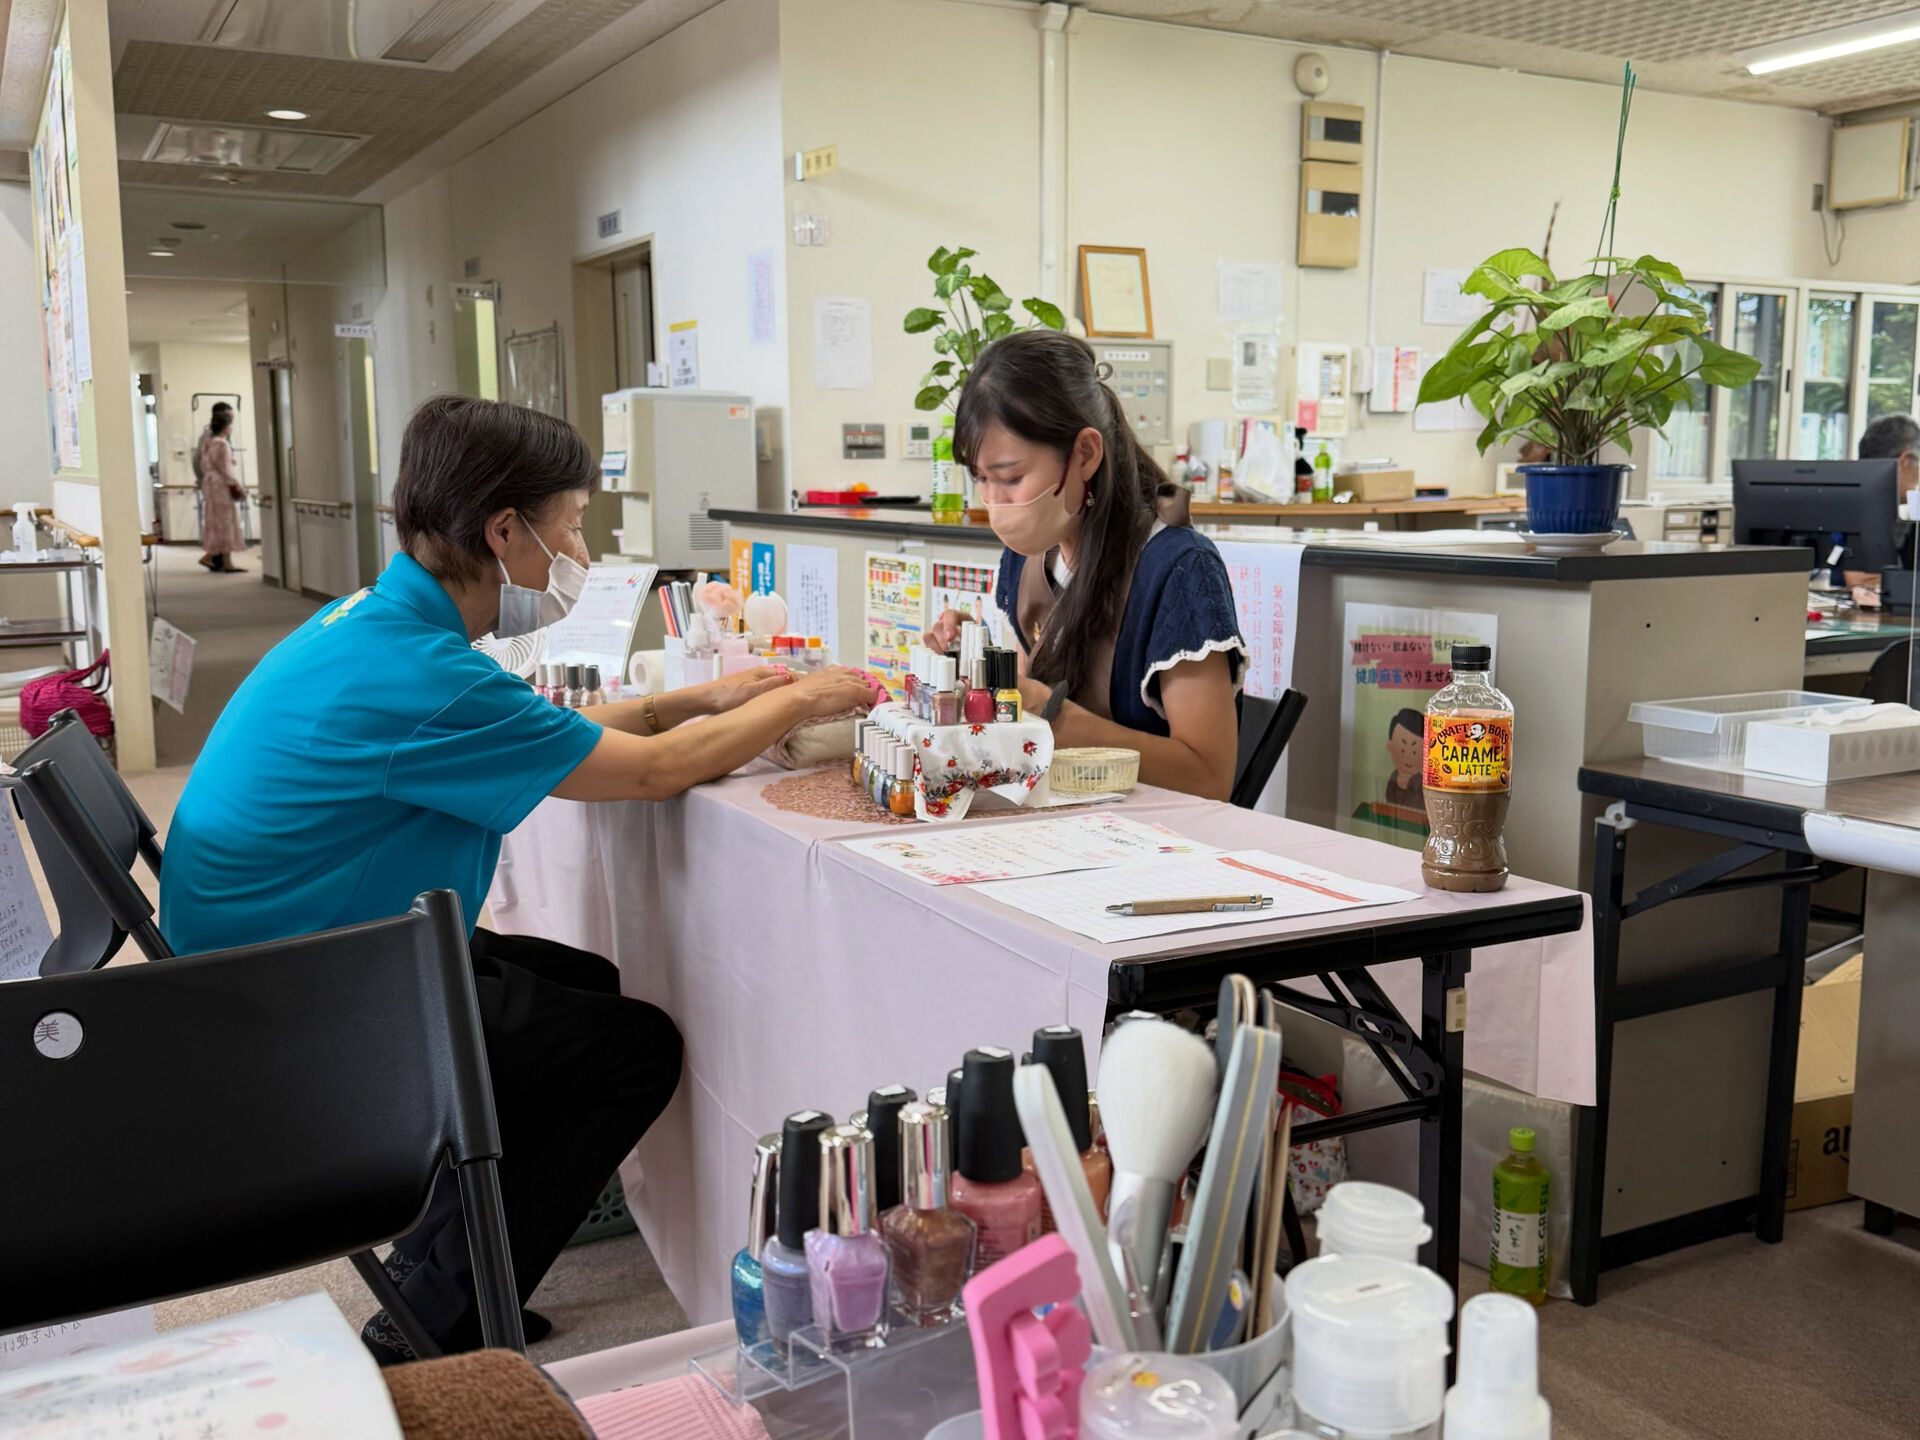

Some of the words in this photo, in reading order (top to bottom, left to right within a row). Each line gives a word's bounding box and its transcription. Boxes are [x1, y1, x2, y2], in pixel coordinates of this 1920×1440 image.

[1437, 723, 1468, 745] CRAFT
[1488, 723, 1509, 745] BOSS
[1441, 745, 1507, 763] CARAMEL
[1458, 764, 1491, 776] LATTE
[35, 1019, 60, 1043] 美
[1538, 1183, 1550, 1240] GREEN
